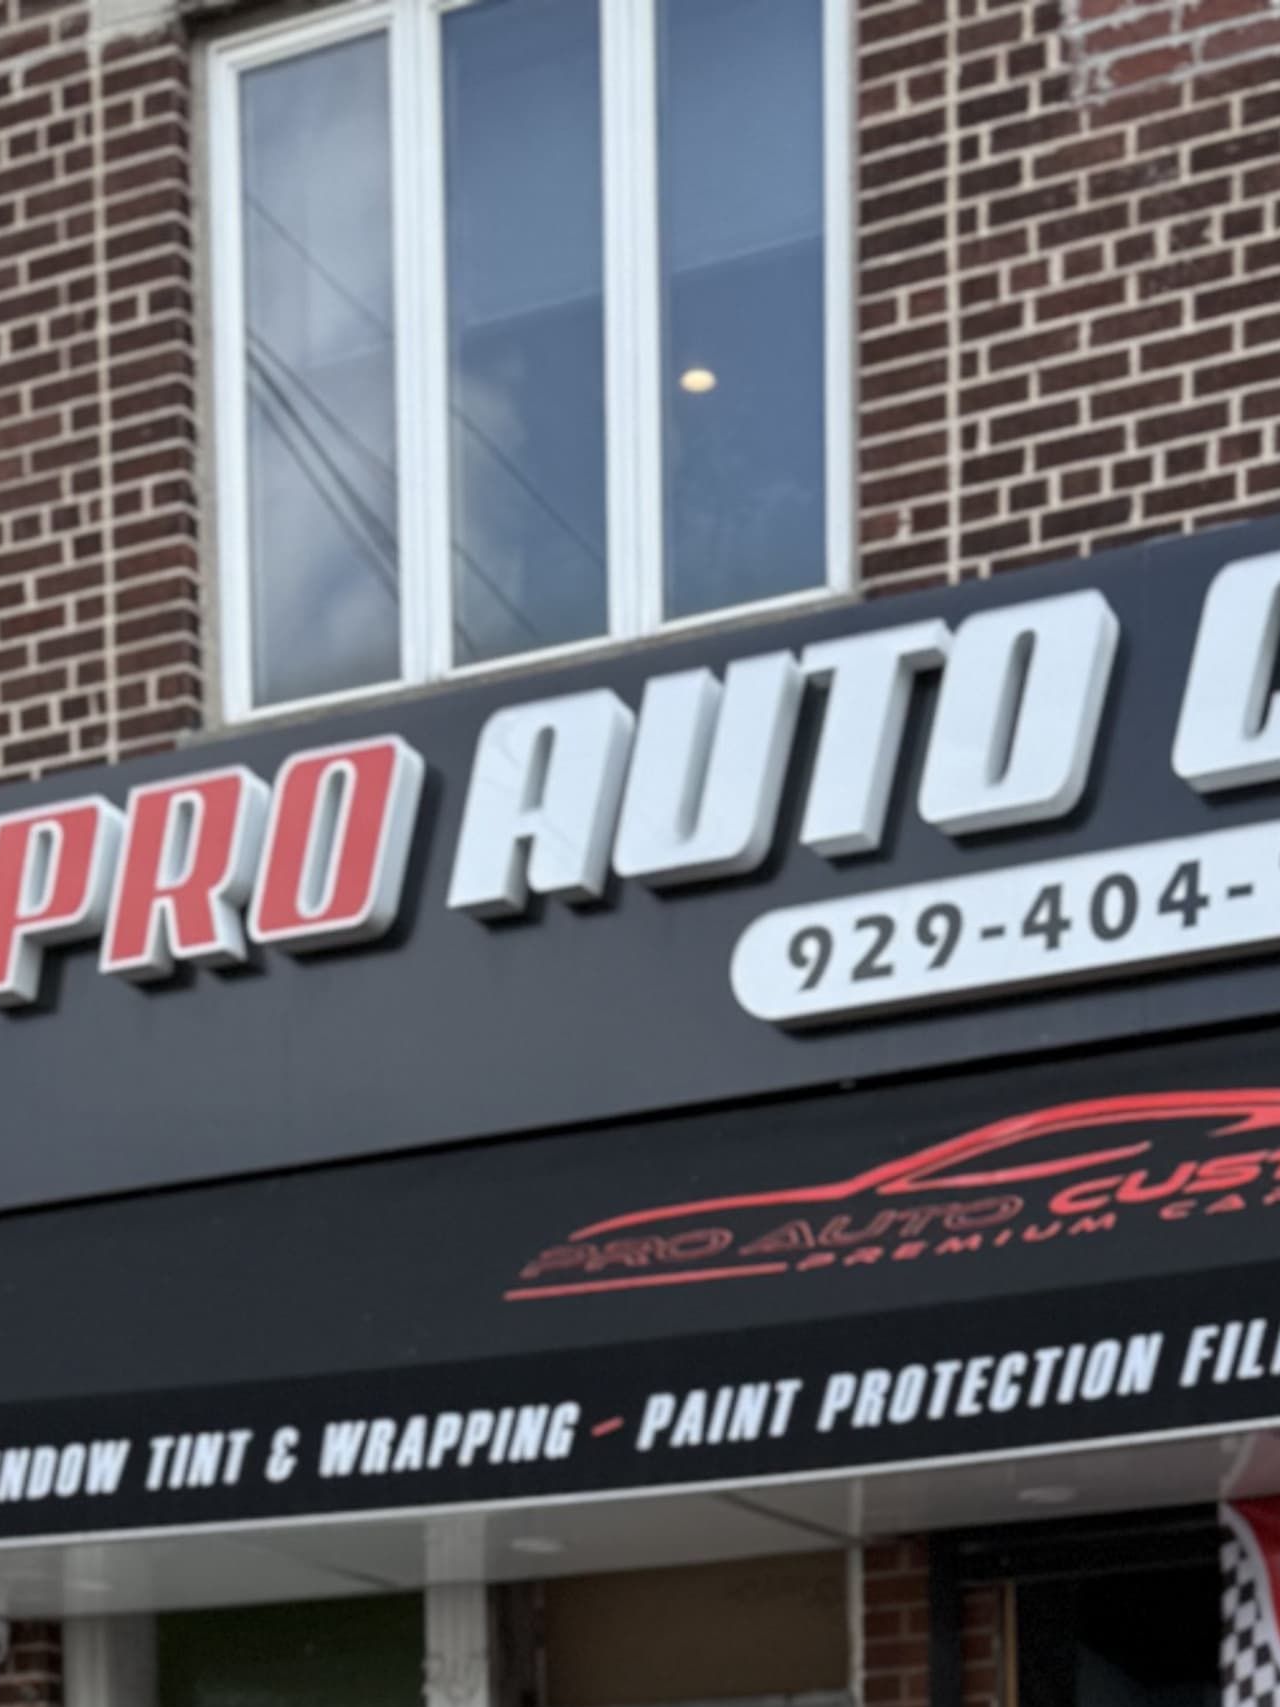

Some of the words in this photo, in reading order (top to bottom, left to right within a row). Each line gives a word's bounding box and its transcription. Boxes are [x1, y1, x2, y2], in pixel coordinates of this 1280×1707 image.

[447, 586, 1122, 922] AUTO
[523, 1227, 732, 1279] PRO
[739, 1195, 1026, 1259] AUTO
[797, 1214, 1118, 1273] PREMIUM
[145, 1428, 252, 1492] TINT
[265, 1426, 297, 1483] &
[318, 1402, 581, 1478] WRAPPING
[636, 1378, 801, 1452] PAINT
[815, 1339, 1158, 1434] PROTECTION
